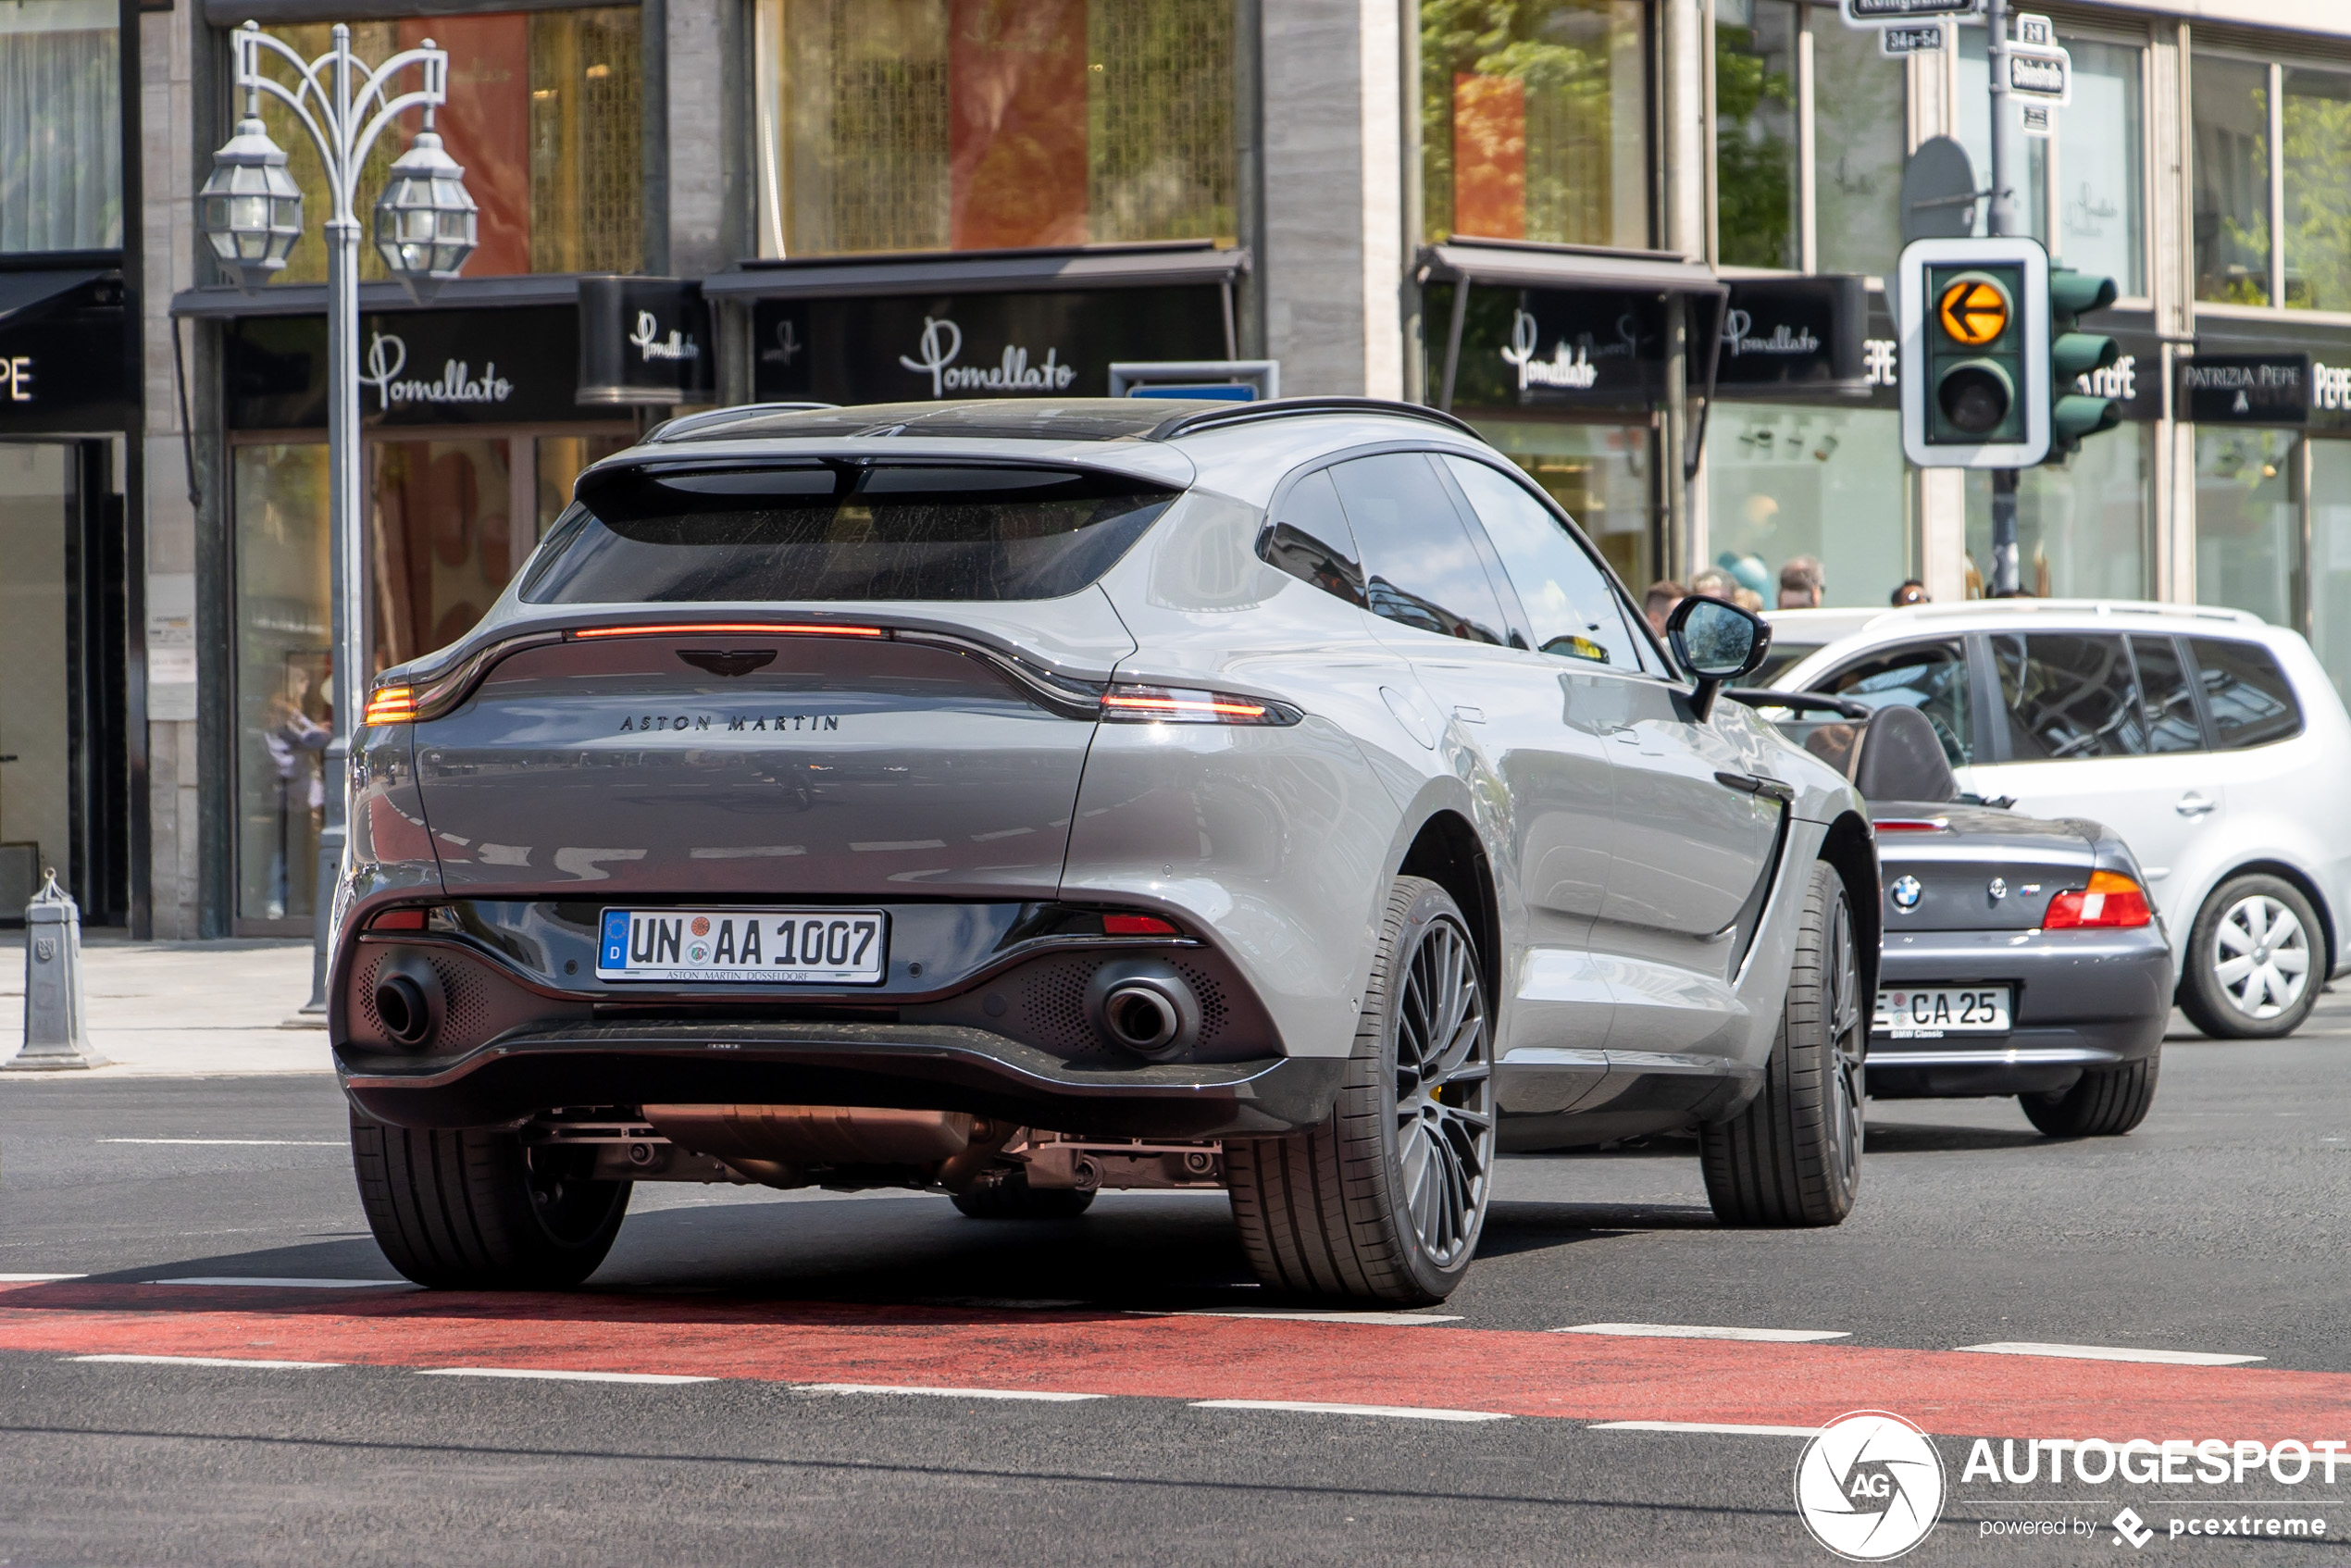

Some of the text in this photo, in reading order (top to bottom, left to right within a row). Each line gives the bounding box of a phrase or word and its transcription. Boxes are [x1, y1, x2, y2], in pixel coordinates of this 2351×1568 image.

[629, 309, 699, 362] Pomellato
[1501, 307, 1598, 391] Pomellato
[1721, 308, 1820, 356] Pomellato
[358, 331, 515, 411] Pomellato
[899, 316, 1076, 399] Pomellato
[2184, 364, 2300, 387] PATRIZIA PEPE
[620, 715, 839, 731] ASTON MARTIN
[610, 947, 620, 961] D
[631, 918, 877, 965] UN AA 1007
[666, 971, 699, 980] ASTON
[704, 971, 741, 980] MARTIN
[1912, 993, 1950, 1025] CA
[1959, 992, 1996, 1024] 25
[1891, 1030, 1945, 1039] BMW Classic
